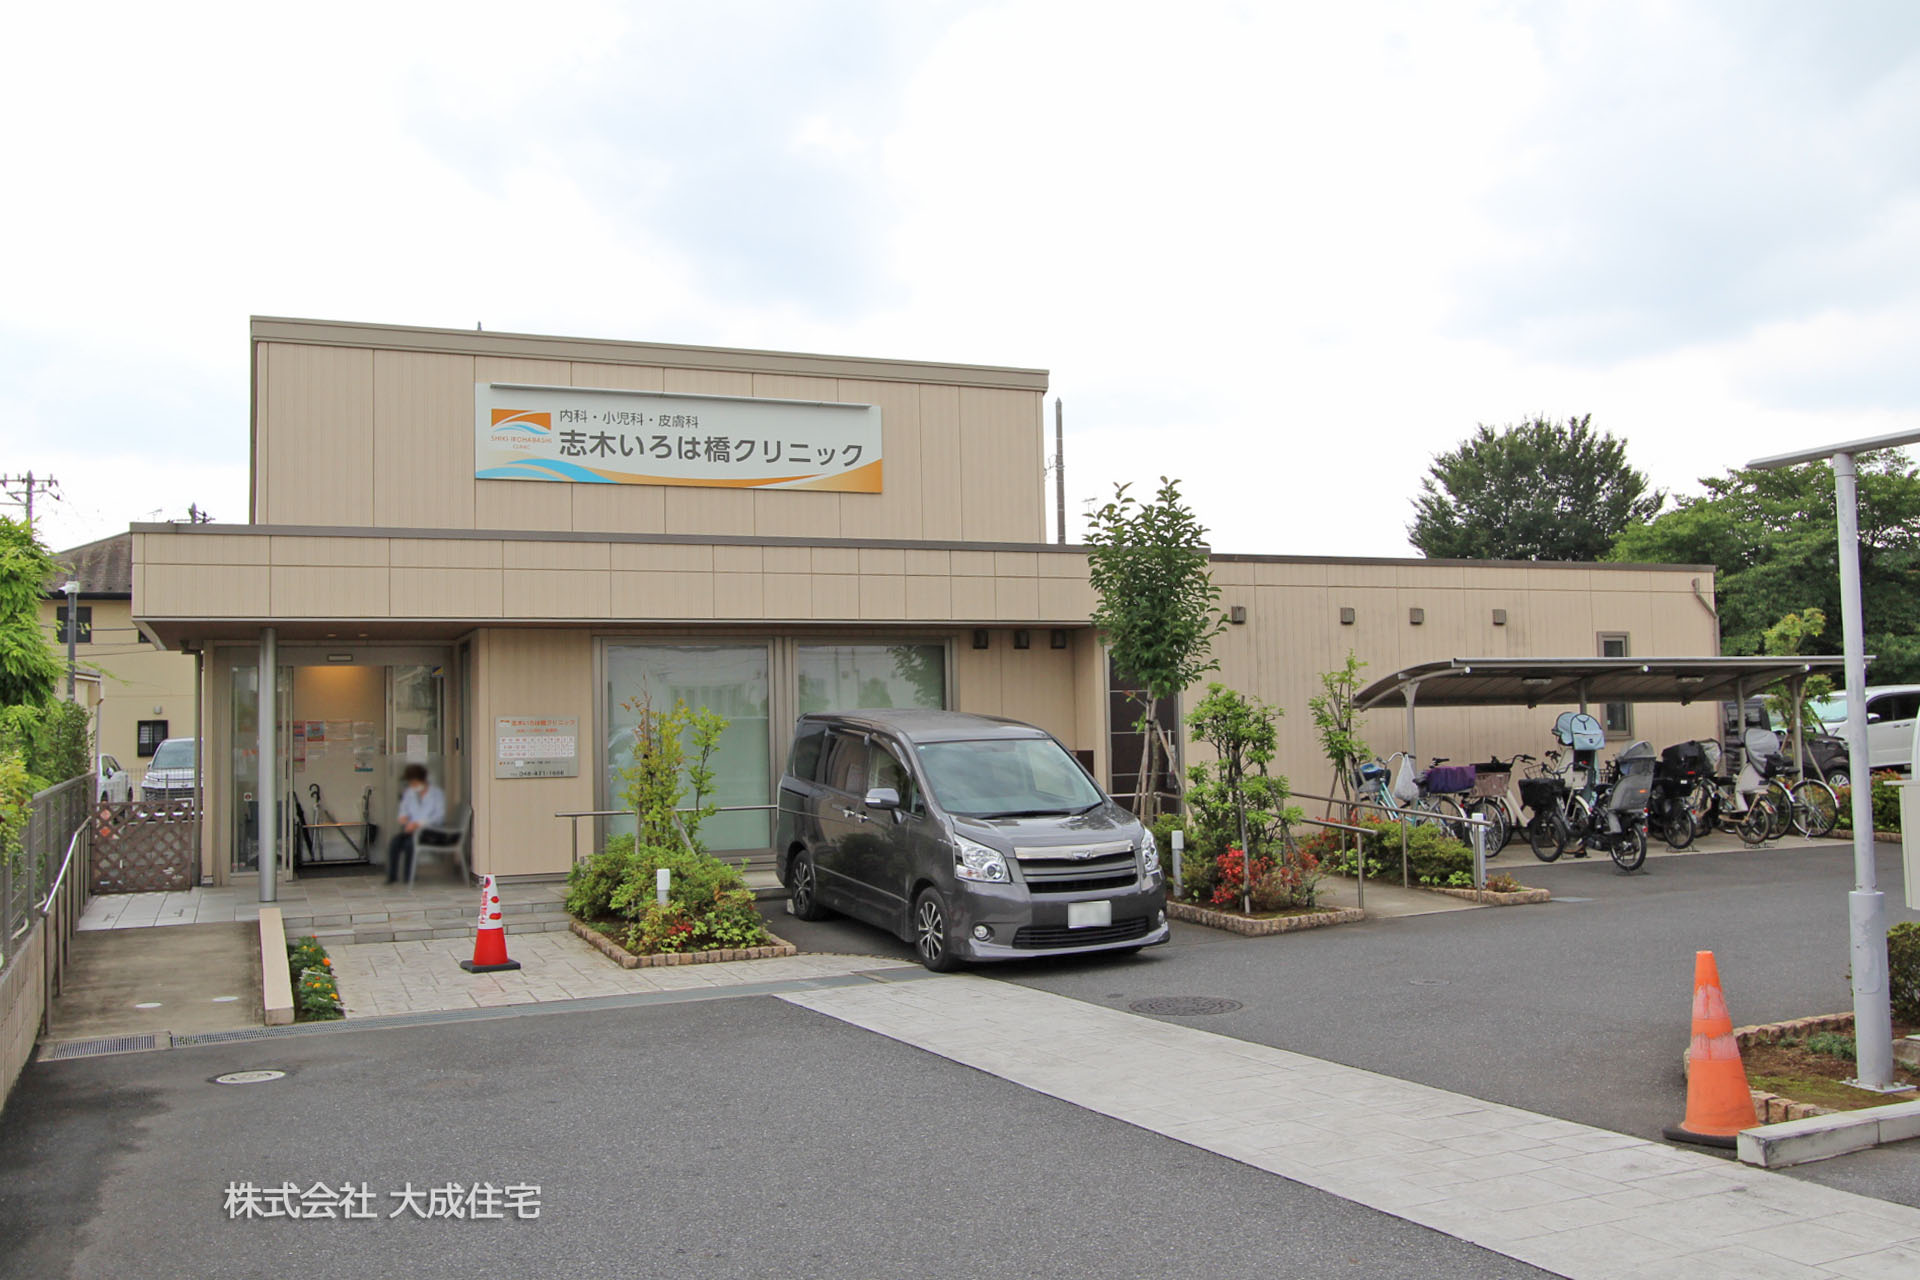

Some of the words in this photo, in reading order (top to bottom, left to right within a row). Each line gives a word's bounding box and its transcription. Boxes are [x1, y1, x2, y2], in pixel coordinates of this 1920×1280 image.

[559, 408, 699, 429] 内科・小児科・皮膚科
[559, 429, 863, 468] 志木いろは橋クリニック
